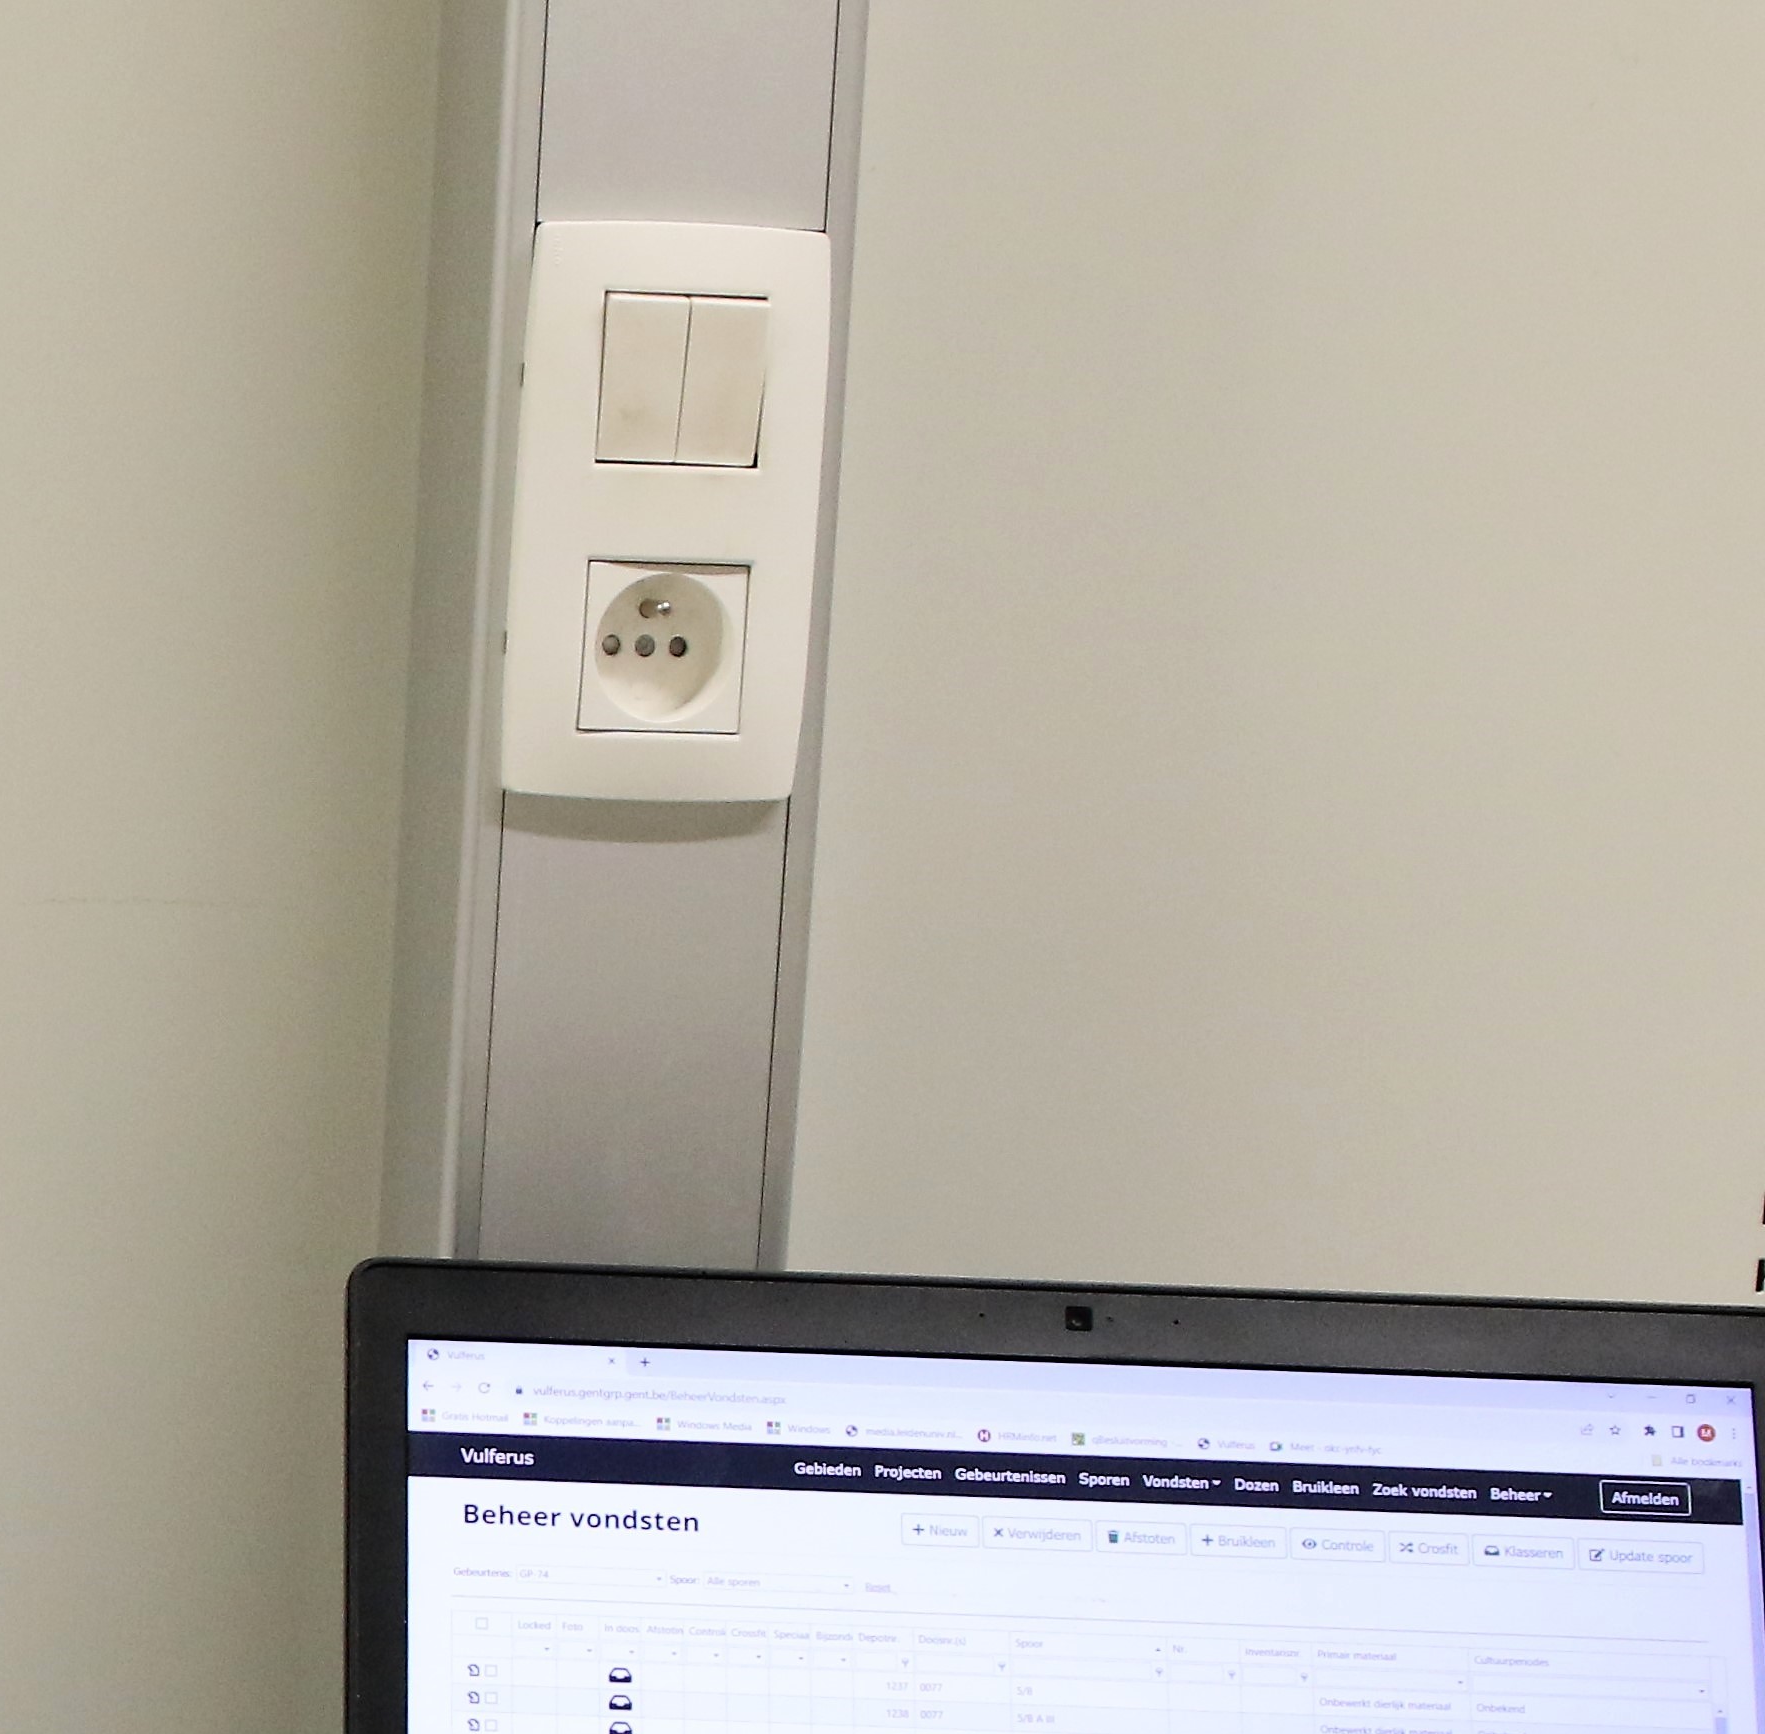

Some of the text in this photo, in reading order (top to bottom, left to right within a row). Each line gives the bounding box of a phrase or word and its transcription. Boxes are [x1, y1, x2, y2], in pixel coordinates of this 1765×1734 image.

[460, 1447, 535, 1466] Vulferus
[793, 1461, 862, 1477] Gebieden
[874, 1464, 942, 1481] Projecten
[954, 1467, 1067, 1484] Gebeurtenissen
[1078, 1471, 1131, 1488] Sporen
[1142, 1474, 1210, 1490] Vondsten
[1234, 1477, 1280, 1492] Dozen
[1292, 1479, 1360, 1495] Bruikleen
[1372, 1482, 1478, 1500] Zoek vondsten
[1490, 1487, 1542, 1502] Beheer
[1611, 1490, 1680, 1506] Afmelden
[464, 1504, 699, 1532] Beheer vondsten
[929, 1524, 968, 1537] Nieuw
[1006, 1527, 1082, 1543] Verwijderen
[1123, 1530, 1176, 1545] Afstoten
[1217, 1534, 1276, 1549] Bruikleen
[1320, 1538, 1374, 1553] Controle
[1417, 1541, 1459, 1556] Crosfit
[1504, 1545, 1564, 1560] Klasseren
[1609, 1549, 1694, 1565] Update spoor
[706, 1576, 726, 1586] Alle
[727, 1578, 761, 1588] sporen
[517, 1620, 552, 1631] Locked
[561, 1621, 584, 1632] Foto
[1014, 1637, 1044, 1649] Spoor
